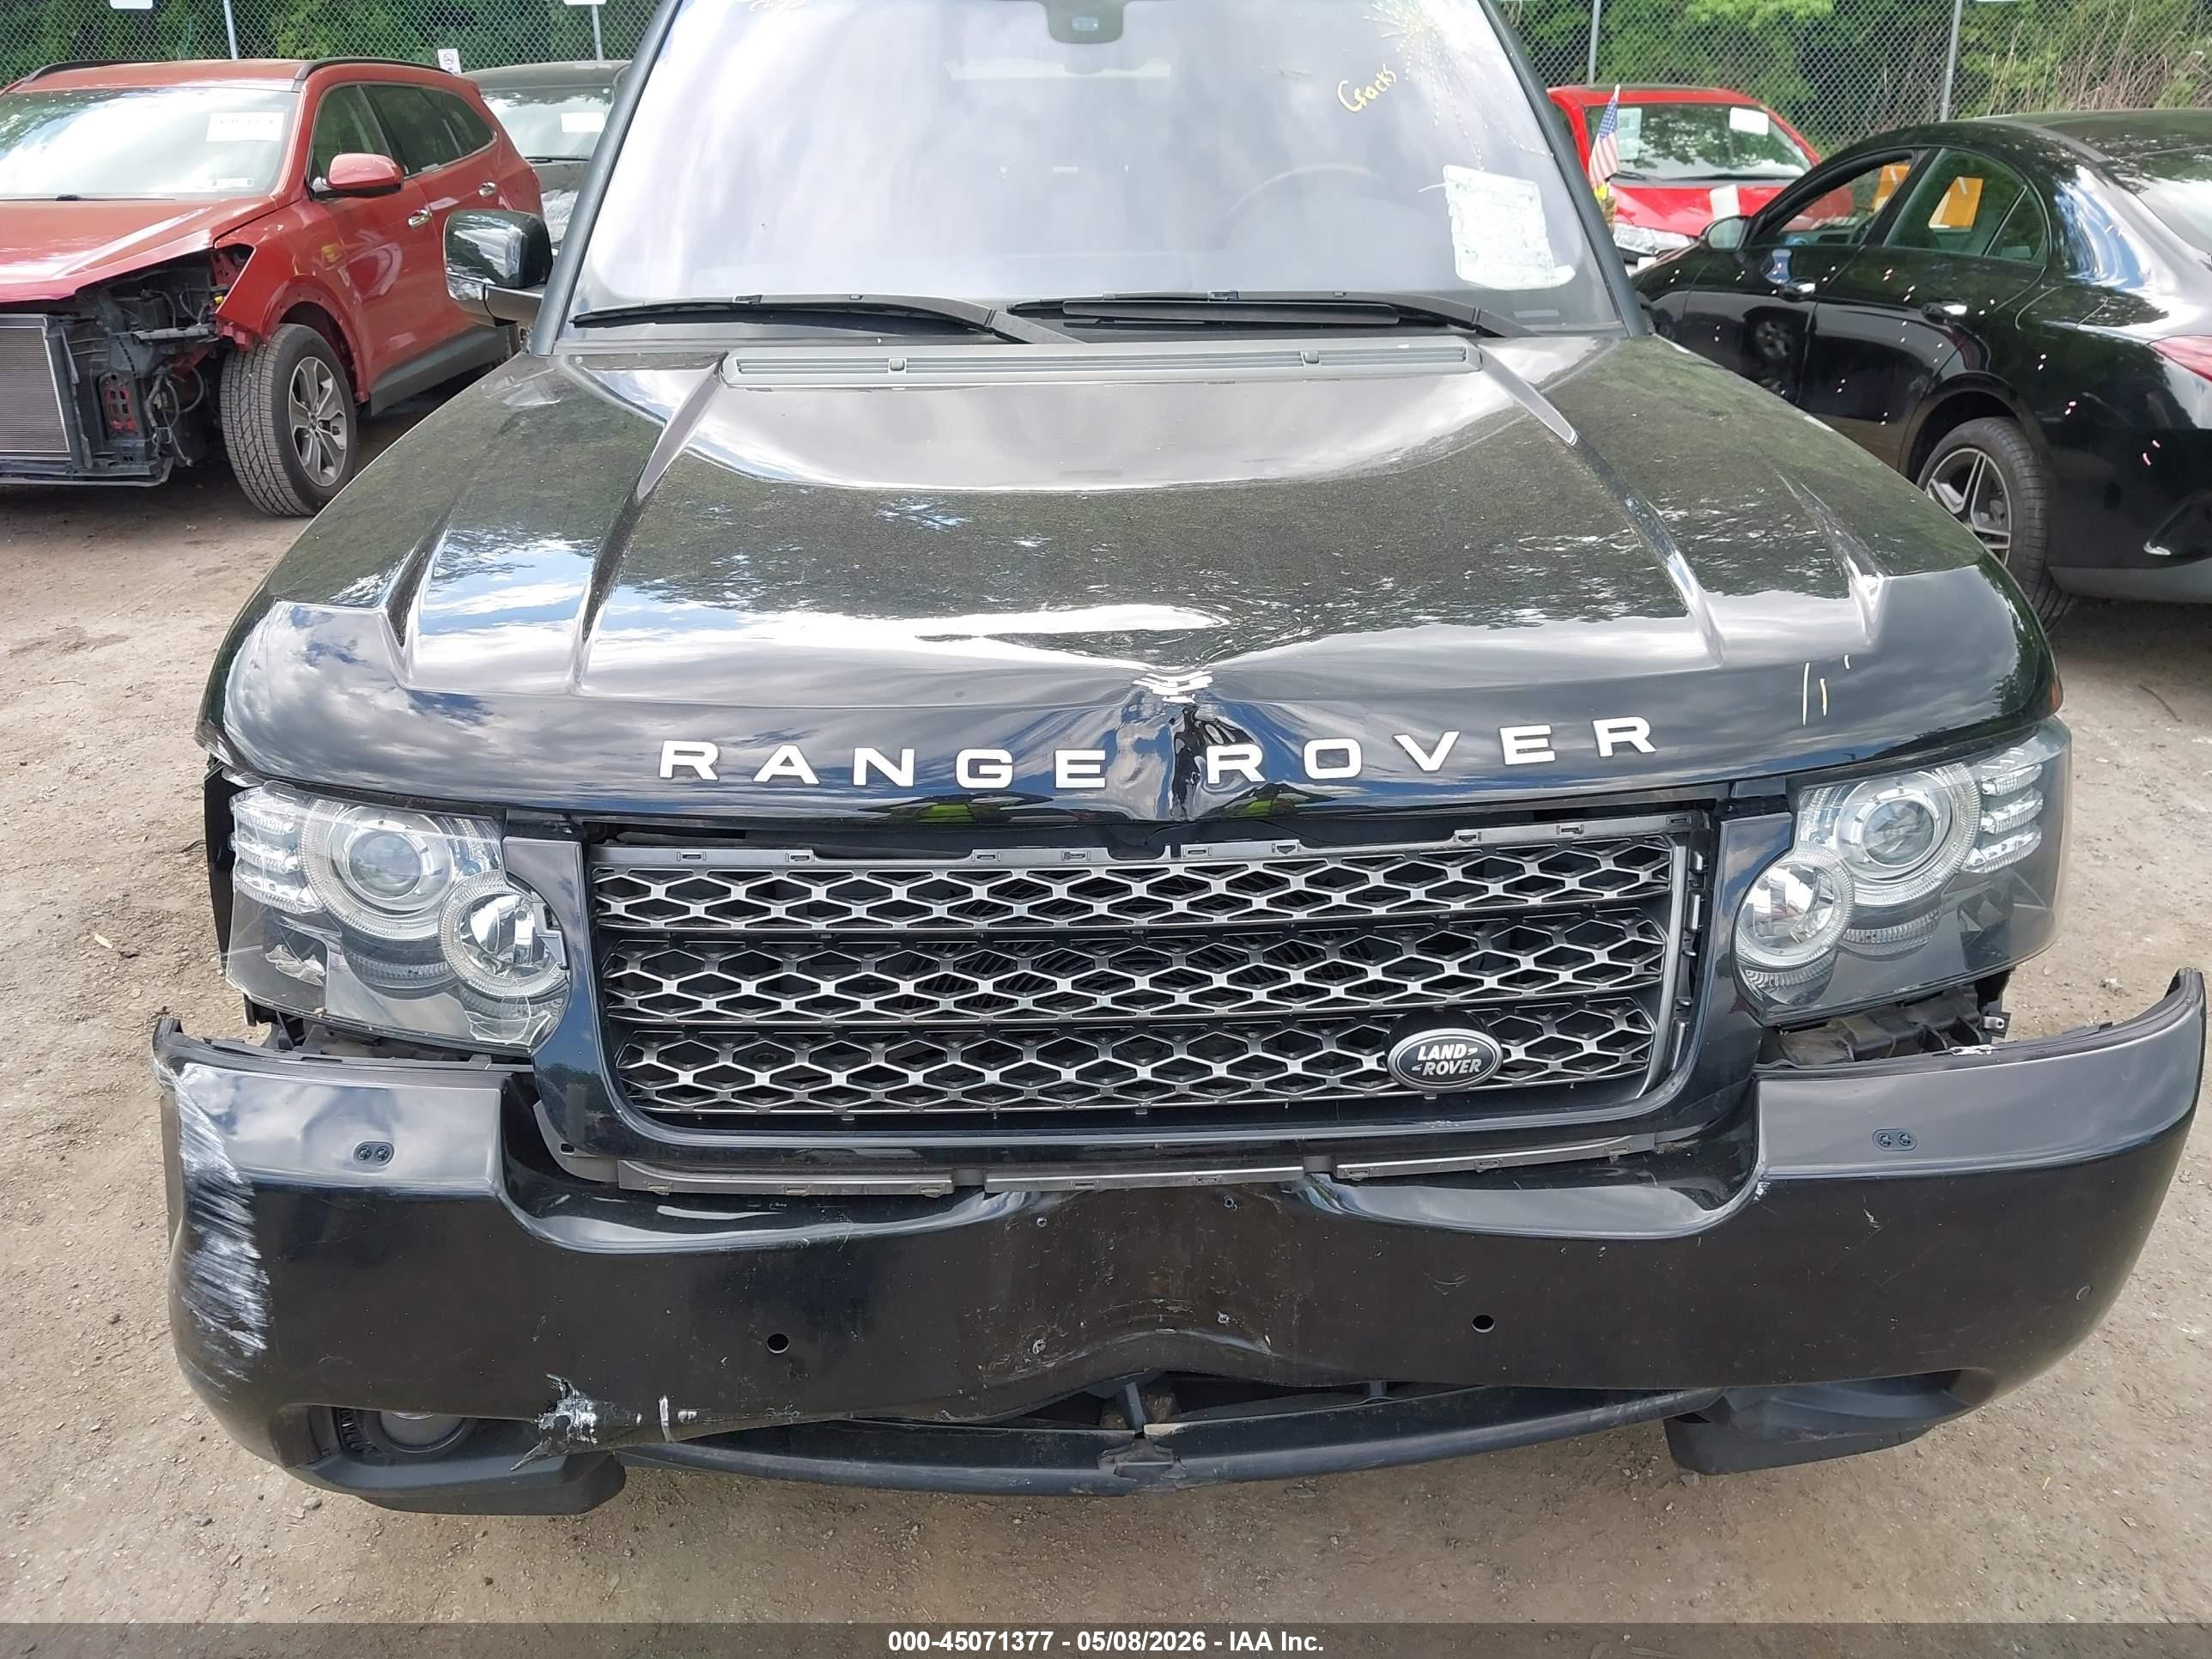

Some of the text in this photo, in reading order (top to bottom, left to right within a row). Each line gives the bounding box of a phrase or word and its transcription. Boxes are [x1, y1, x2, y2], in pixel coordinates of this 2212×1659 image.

[659, 715, 1657, 789] RANGE ROVER
[1417, 1043, 1467, 1061] LAND
[1421, 1058, 1482, 1076] ROVER
